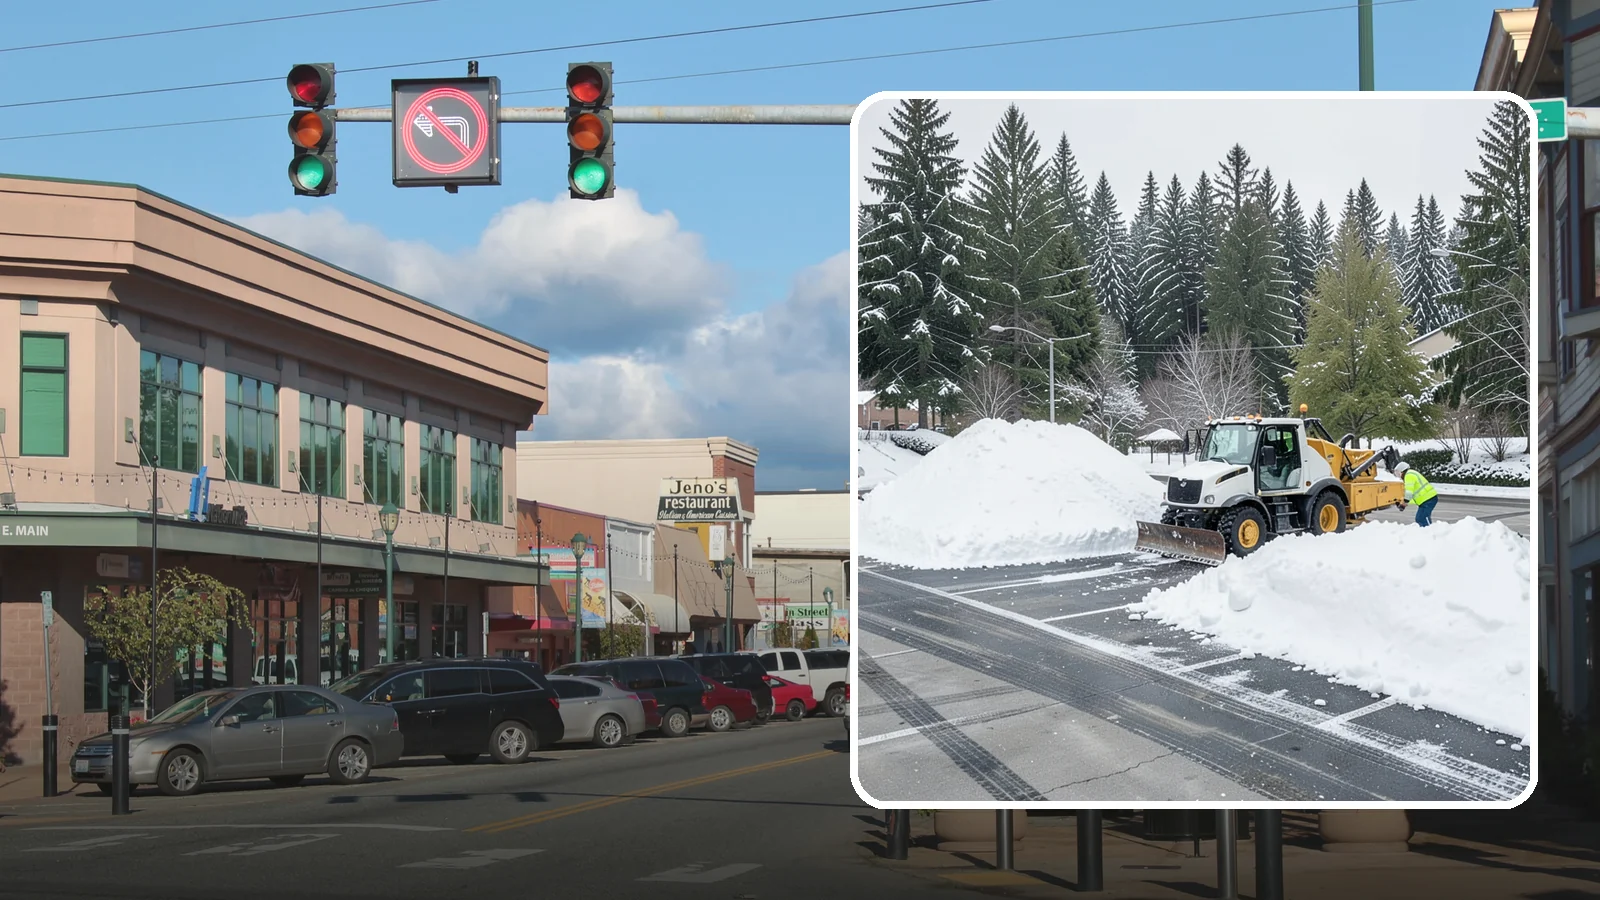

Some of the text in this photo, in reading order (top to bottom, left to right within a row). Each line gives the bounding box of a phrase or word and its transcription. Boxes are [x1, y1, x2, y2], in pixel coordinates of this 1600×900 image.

[669, 479, 727, 494] Jeno's
[665, 496, 731, 509] restaurant
[658, 509, 681, 519] Italian
[685, 509, 714, 519] American
[715, 509, 737, 519] Cuisine
[2, 525, 49, 537] E. MAIN
[797, 607, 828, 617] Street
[790, 619, 824, 627] lass
